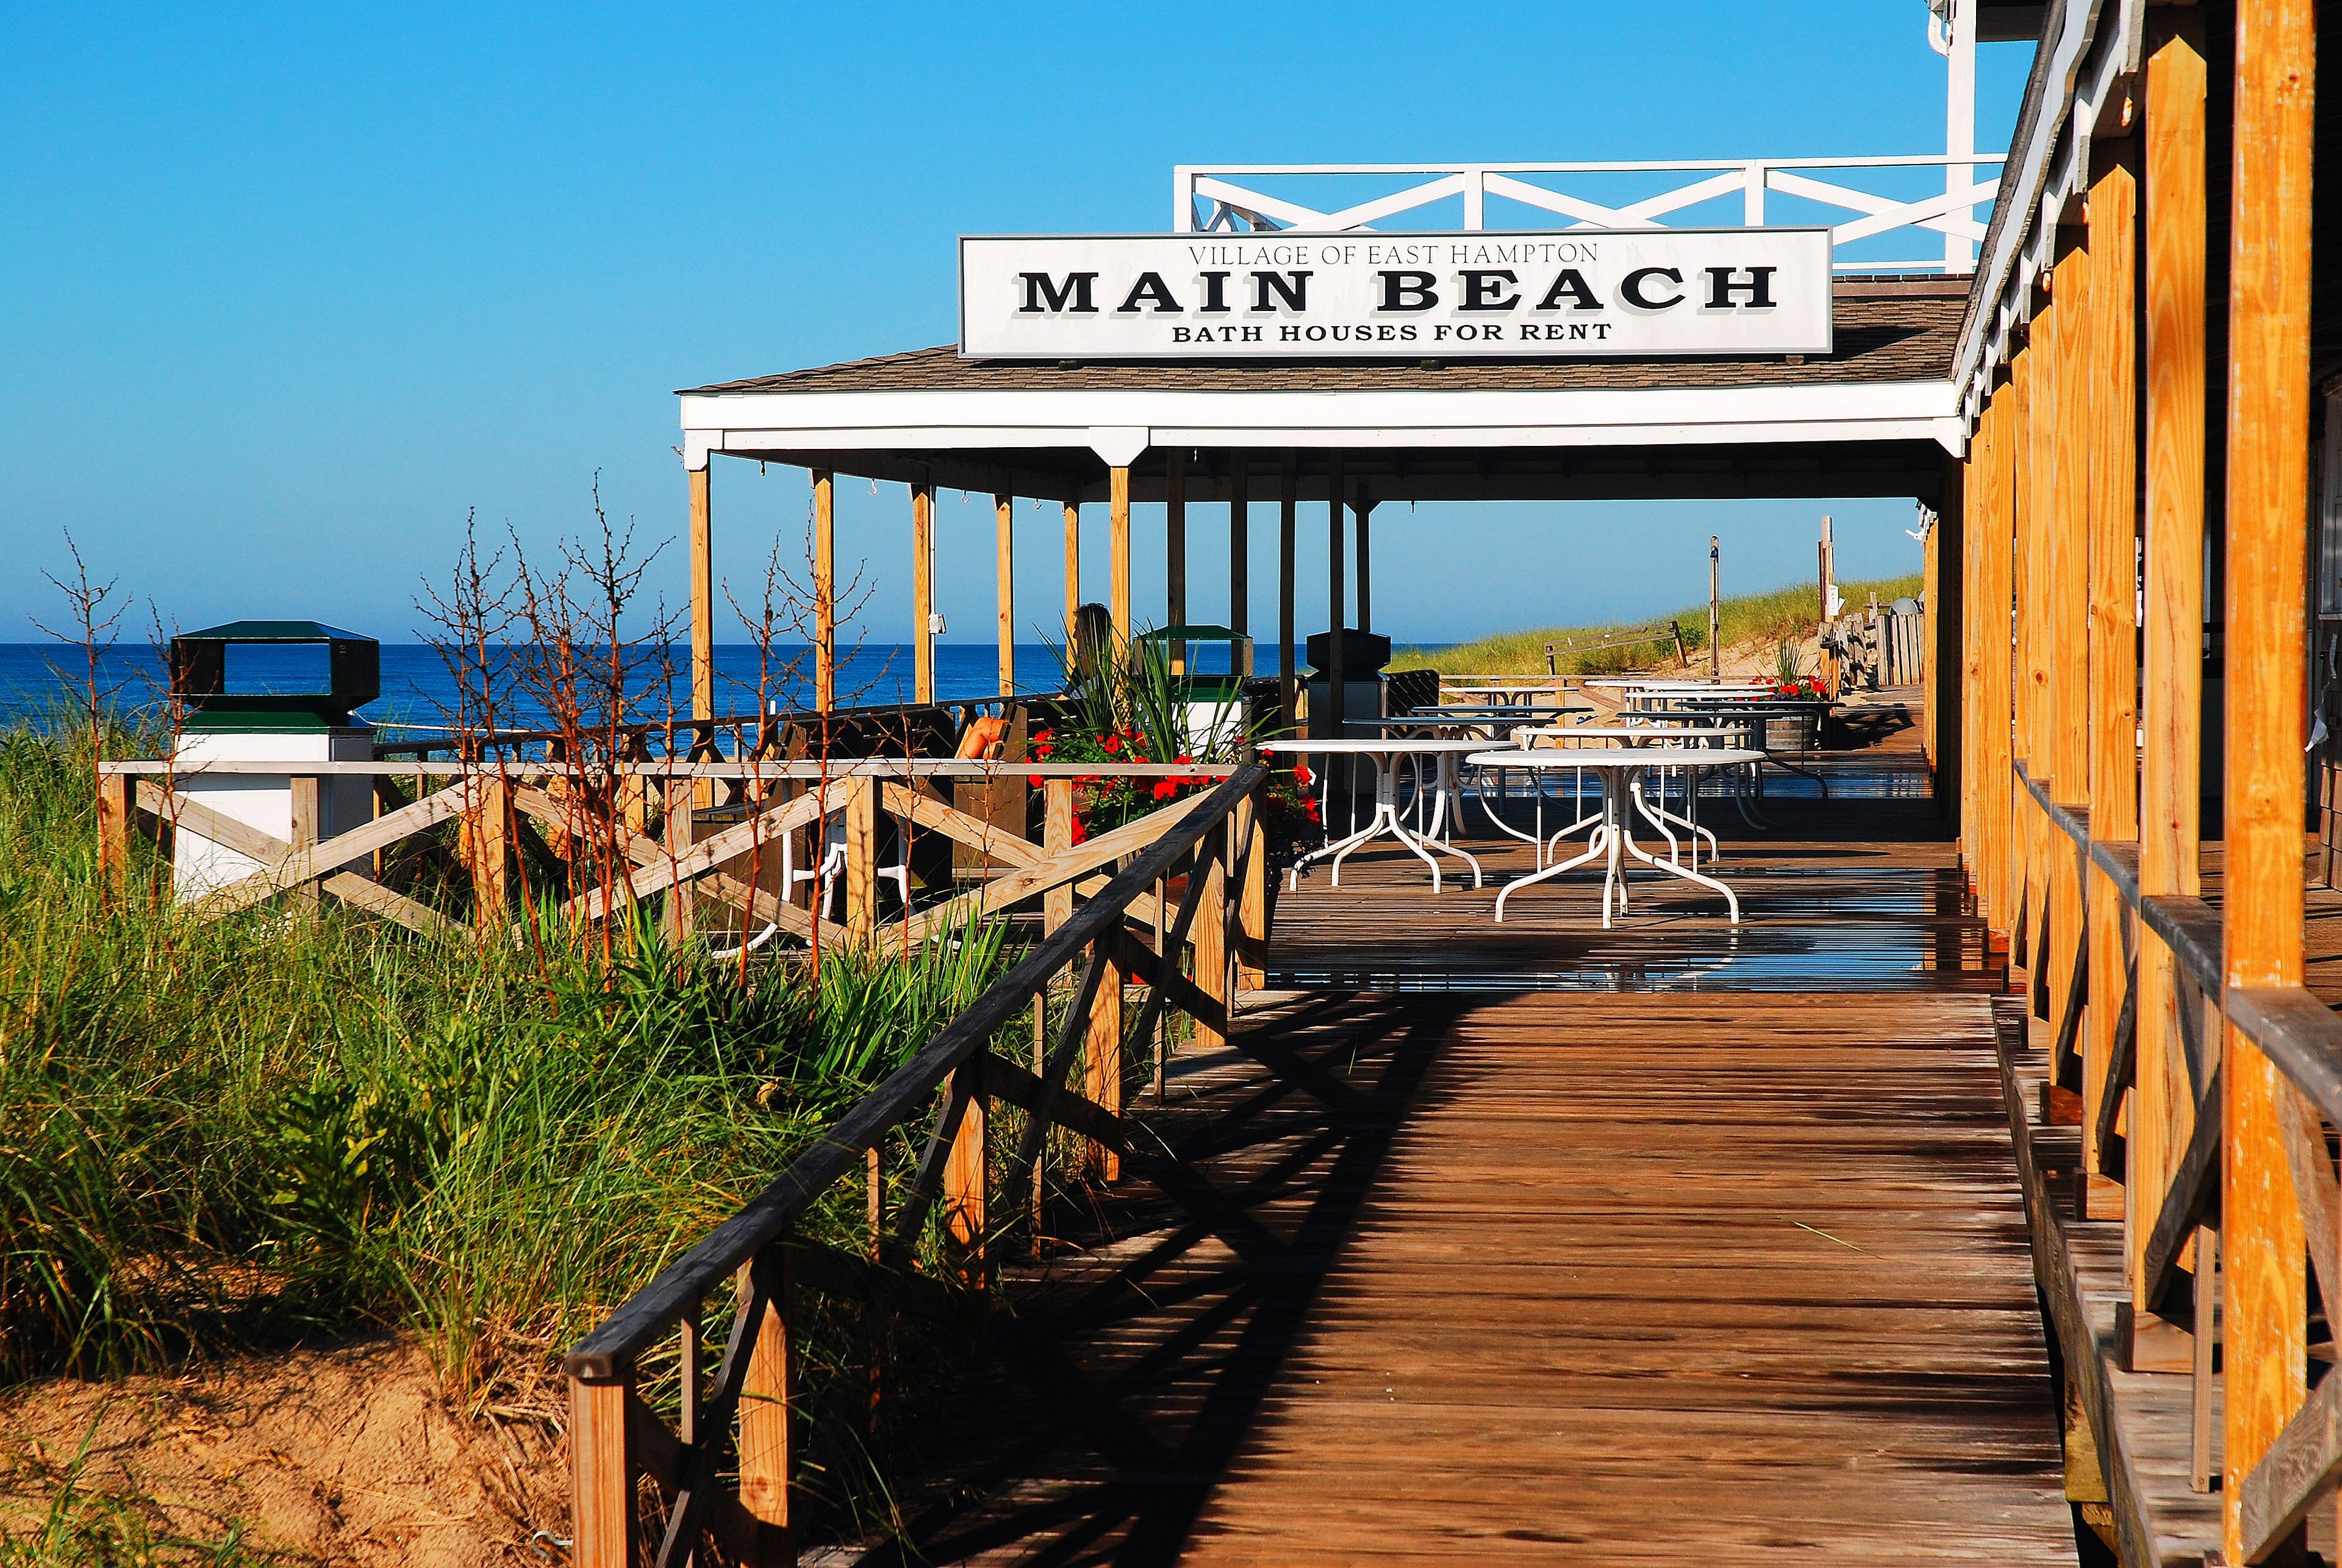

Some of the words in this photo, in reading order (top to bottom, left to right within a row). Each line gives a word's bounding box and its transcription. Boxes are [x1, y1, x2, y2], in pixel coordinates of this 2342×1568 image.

[1188, 245, 1309, 265] VILLAGE
[1322, 245, 1356, 265] OF
[1368, 245, 1439, 264] EAST
[1450, 243, 1598, 264] HAMPTON
[1018, 271, 1314, 313] MAIN
[1376, 267, 1777, 312] BEACH
[1172, 326, 1263, 343] BATH
[1280, 324, 1417, 342] HOUSES
[1434, 324, 1503, 340] FOR
[1519, 323, 1612, 340] RENT
